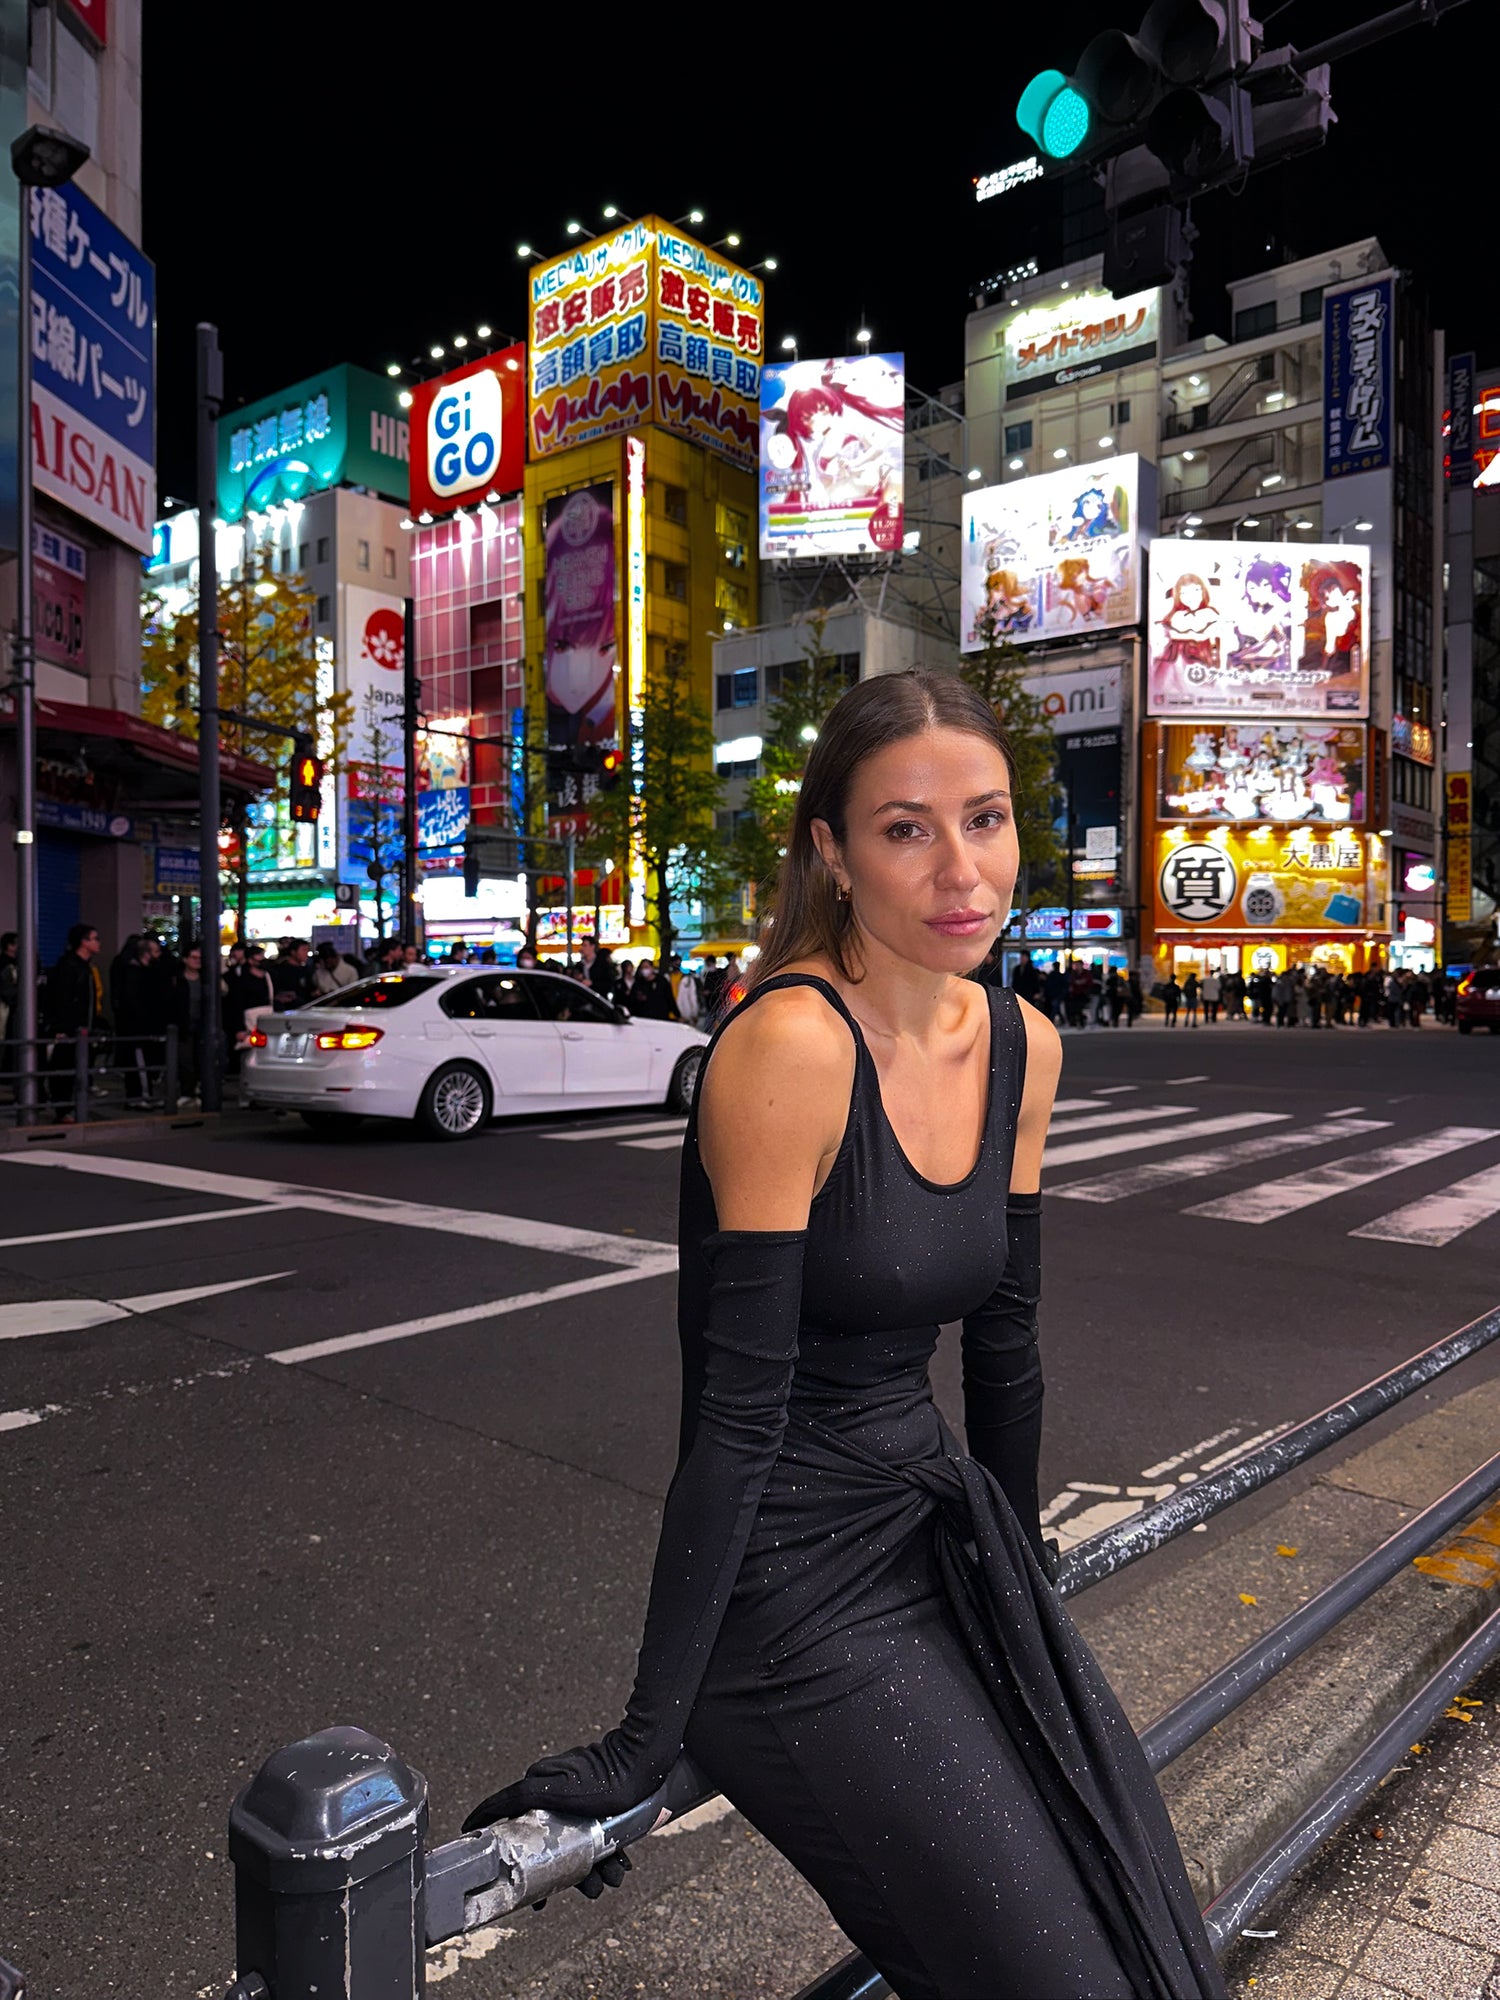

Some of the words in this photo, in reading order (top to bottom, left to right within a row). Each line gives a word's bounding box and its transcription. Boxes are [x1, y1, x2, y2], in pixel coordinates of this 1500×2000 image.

[535, 263, 646, 344] 激安販売
[660, 268, 758, 351] 激安販売
[1017, 307, 1147, 369] メイドカジノ
[535, 313, 645, 395] 高額買取
[659, 321, 758, 395] 高額買取
[435, 391, 471, 440] Gi
[533, 372, 649, 452] Mulan
[658, 374, 759, 457] Mulan
[435, 432, 494, 486] GO
[1170, 857, 1226, 911] 質
[1282, 843, 1362, 868] 大黒屋
